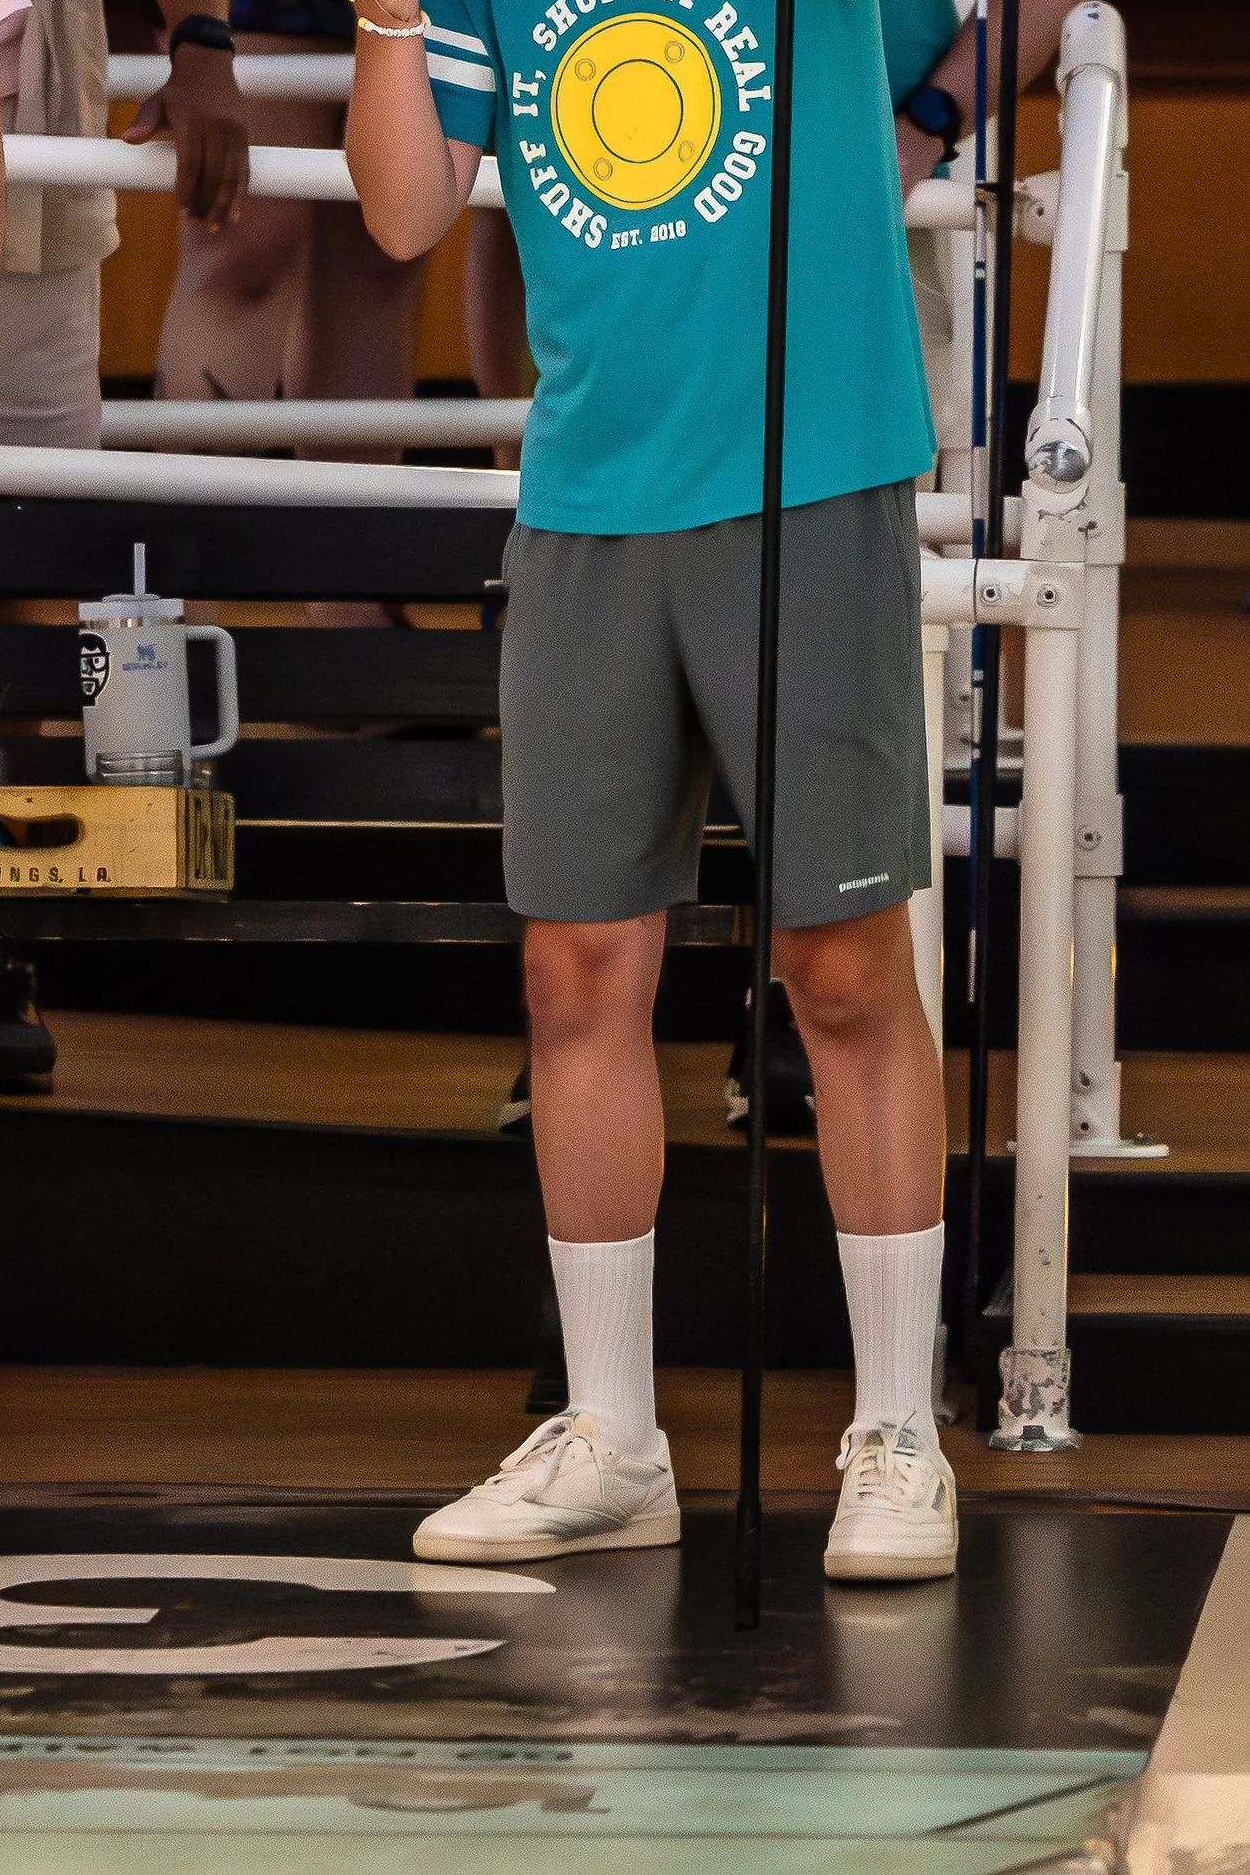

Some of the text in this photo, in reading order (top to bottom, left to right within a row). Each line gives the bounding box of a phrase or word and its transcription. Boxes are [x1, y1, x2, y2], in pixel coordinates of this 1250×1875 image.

[512, 69, 548, 117] IT,
[703, 1, 772, 113] REAL
[518, 139, 608, 249] SHUFF
[693, 130, 767, 223] GOOD
